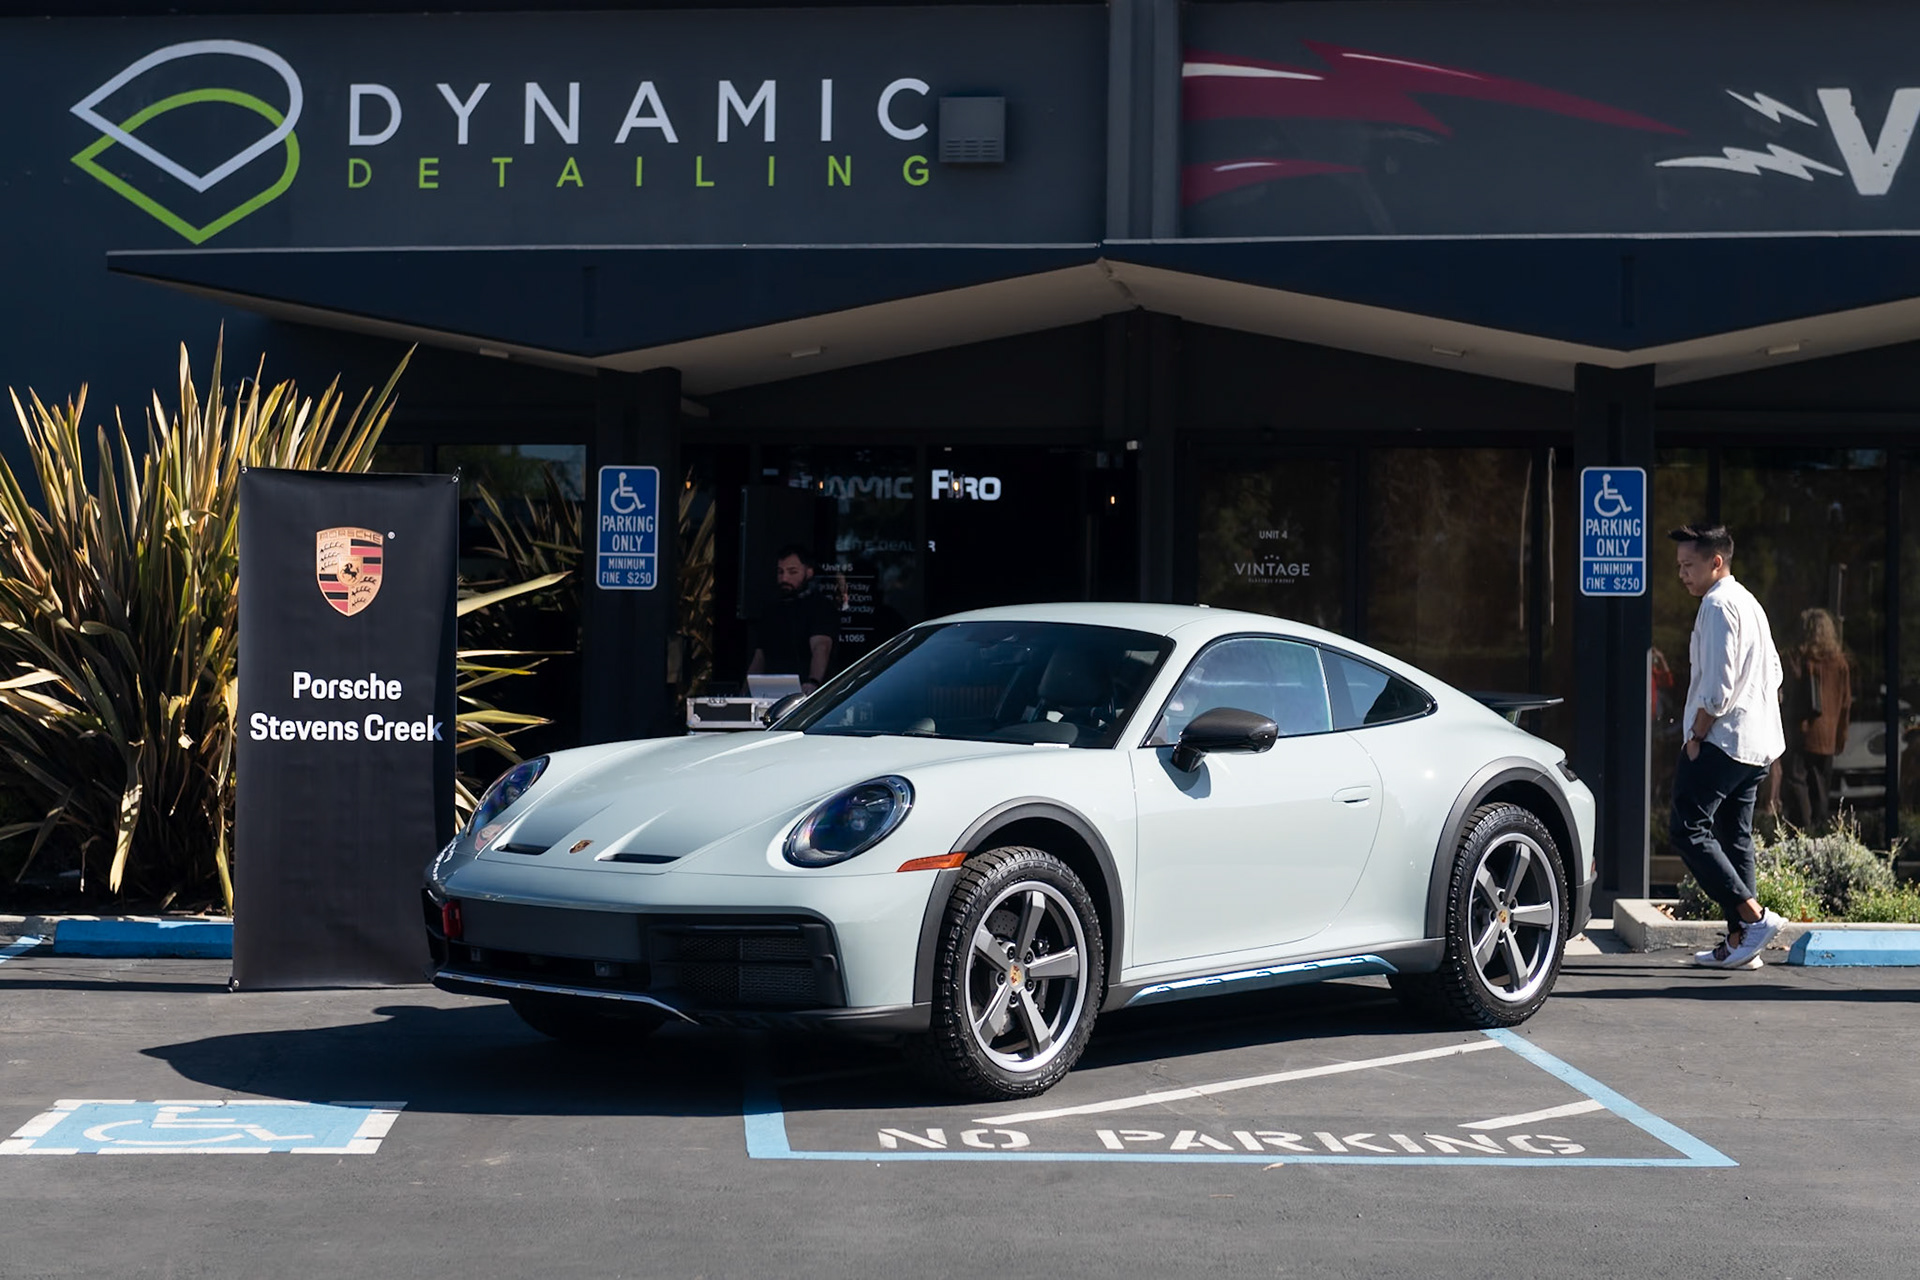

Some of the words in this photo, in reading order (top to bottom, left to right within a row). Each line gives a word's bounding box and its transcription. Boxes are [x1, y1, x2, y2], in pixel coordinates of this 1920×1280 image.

[349, 77, 930, 146] DYNAMIC
[1815, 87, 1920, 196] V
[348, 155, 929, 189] DETAILING
[602, 515, 654, 533] PARKING
[1585, 518, 1641, 537] PARKING
[319, 529, 381, 543] PORSCHE
[611, 534, 644, 552] ONLY
[1258, 530, 1280, 540] UNIT
[1281, 530, 1288, 540] 4
[1596, 538, 1631, 557] ONLY
[608, 557, 646, 571] MINIMUM
[1234, 562, 1310, 577] VINTAGE
[1592, 562, 1633, 576] MINIMUM
[601, 571, 621, 585] FINE
[626, 571, 652, 585] $250
[1586, 577, 1607, 590] FINE
[1613, 577, 1640, 591] $250
[292, 671, 402, 700] Porsche
[249, 712, 359, 741] Stevens
[364, 713, 444, 742] Creek
[877, 1128, 1032, 1150] NO
[1095, 1128, 1586, 1156] PARKING
